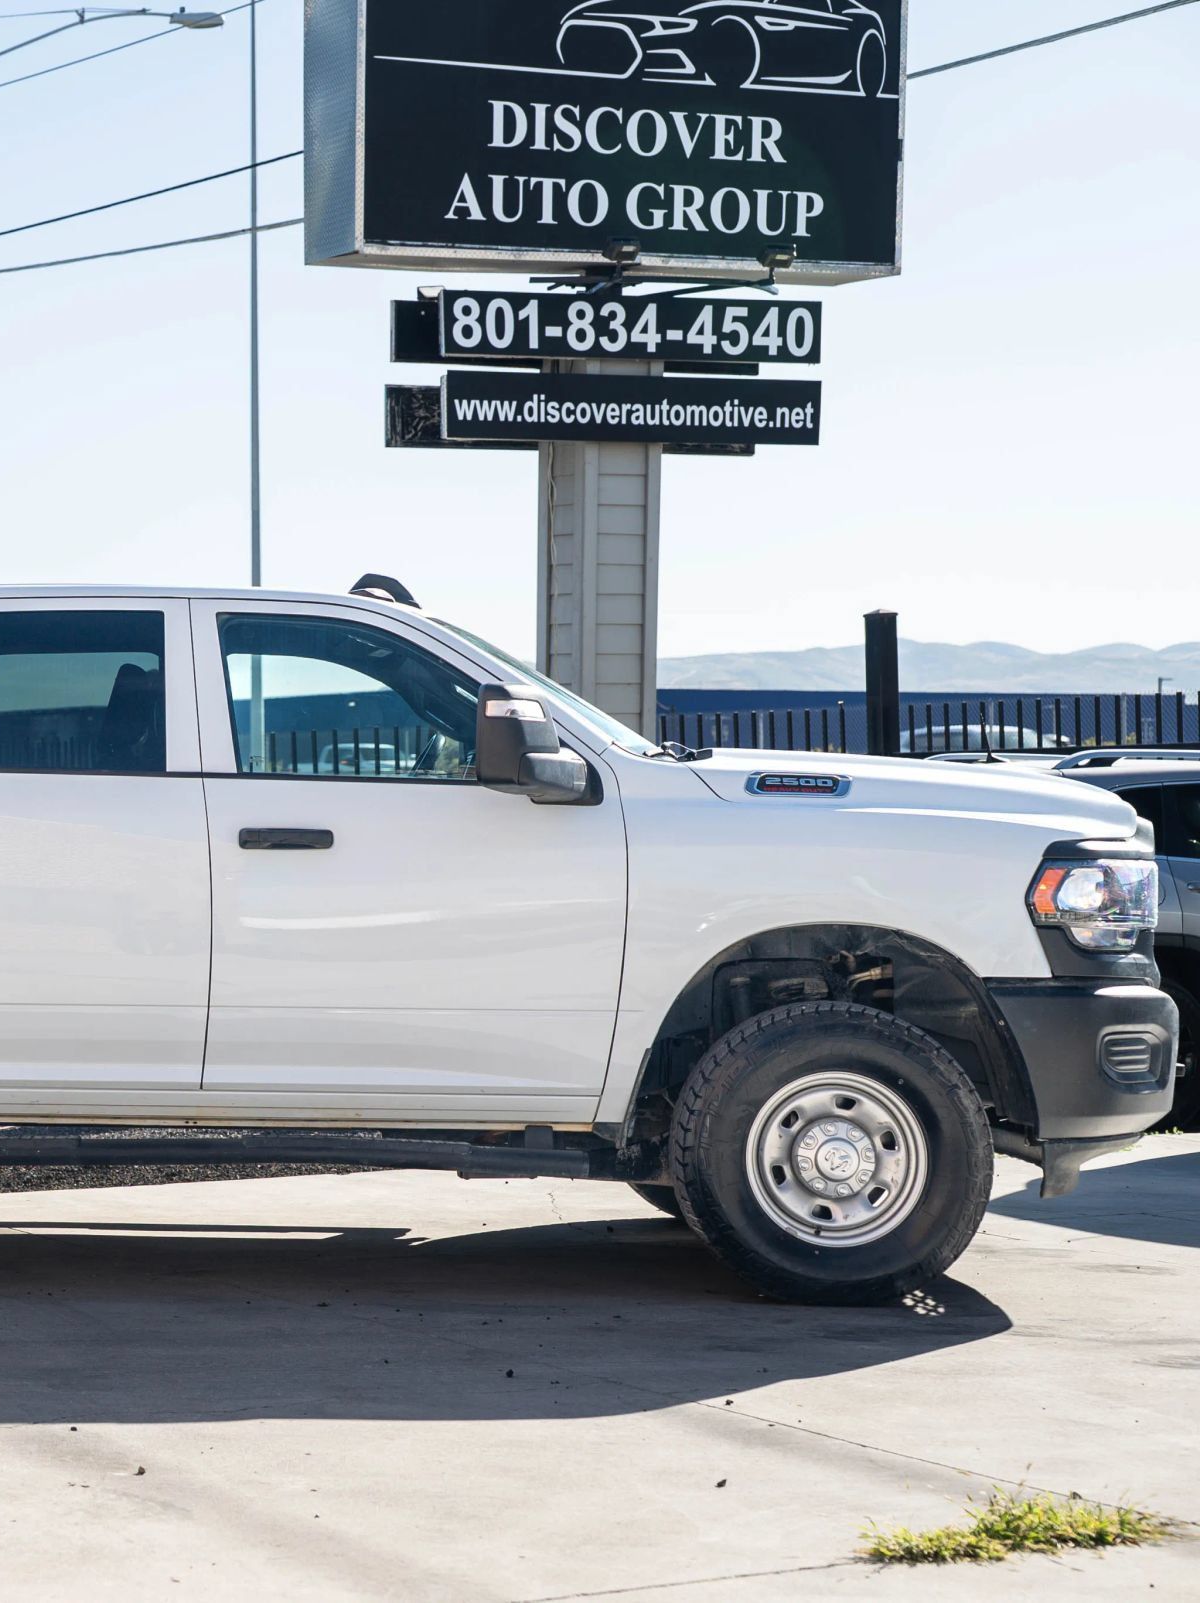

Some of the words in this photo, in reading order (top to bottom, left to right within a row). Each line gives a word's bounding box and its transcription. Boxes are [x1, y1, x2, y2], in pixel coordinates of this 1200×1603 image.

[487, 99, 788, 164] DISCOVER
[444, 172, 609, 228] AUTO
[625, 182, 824, 237] GROUP
[452, 296, 814, 357] 801-834-4540
[453, 393, 814, 429] www.discoverautomotive.net
[764, 777, 833, 787] 2500
